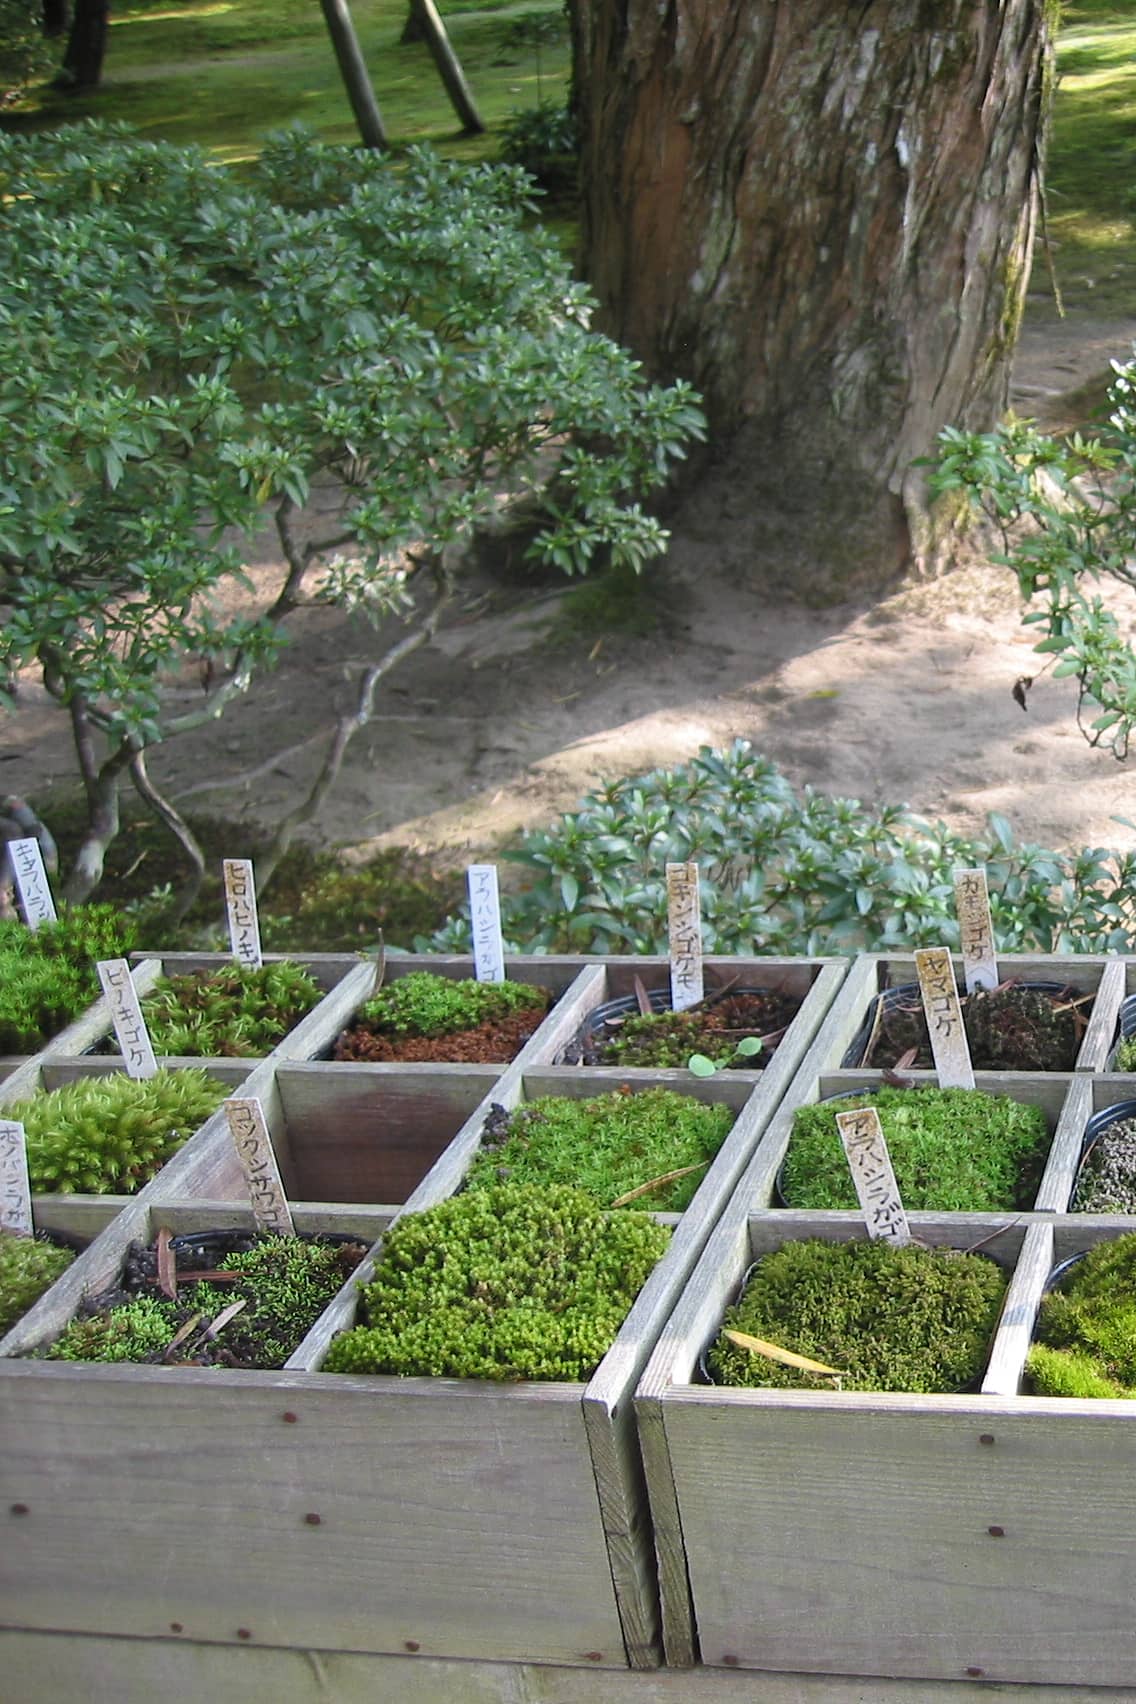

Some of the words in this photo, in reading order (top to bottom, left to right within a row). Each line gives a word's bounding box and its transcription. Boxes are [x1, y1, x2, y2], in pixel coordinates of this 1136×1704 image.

[669, 866, 699, 999] コキンシゴケモ
[106, 966, 146, 1067] ヒノキゴケ
